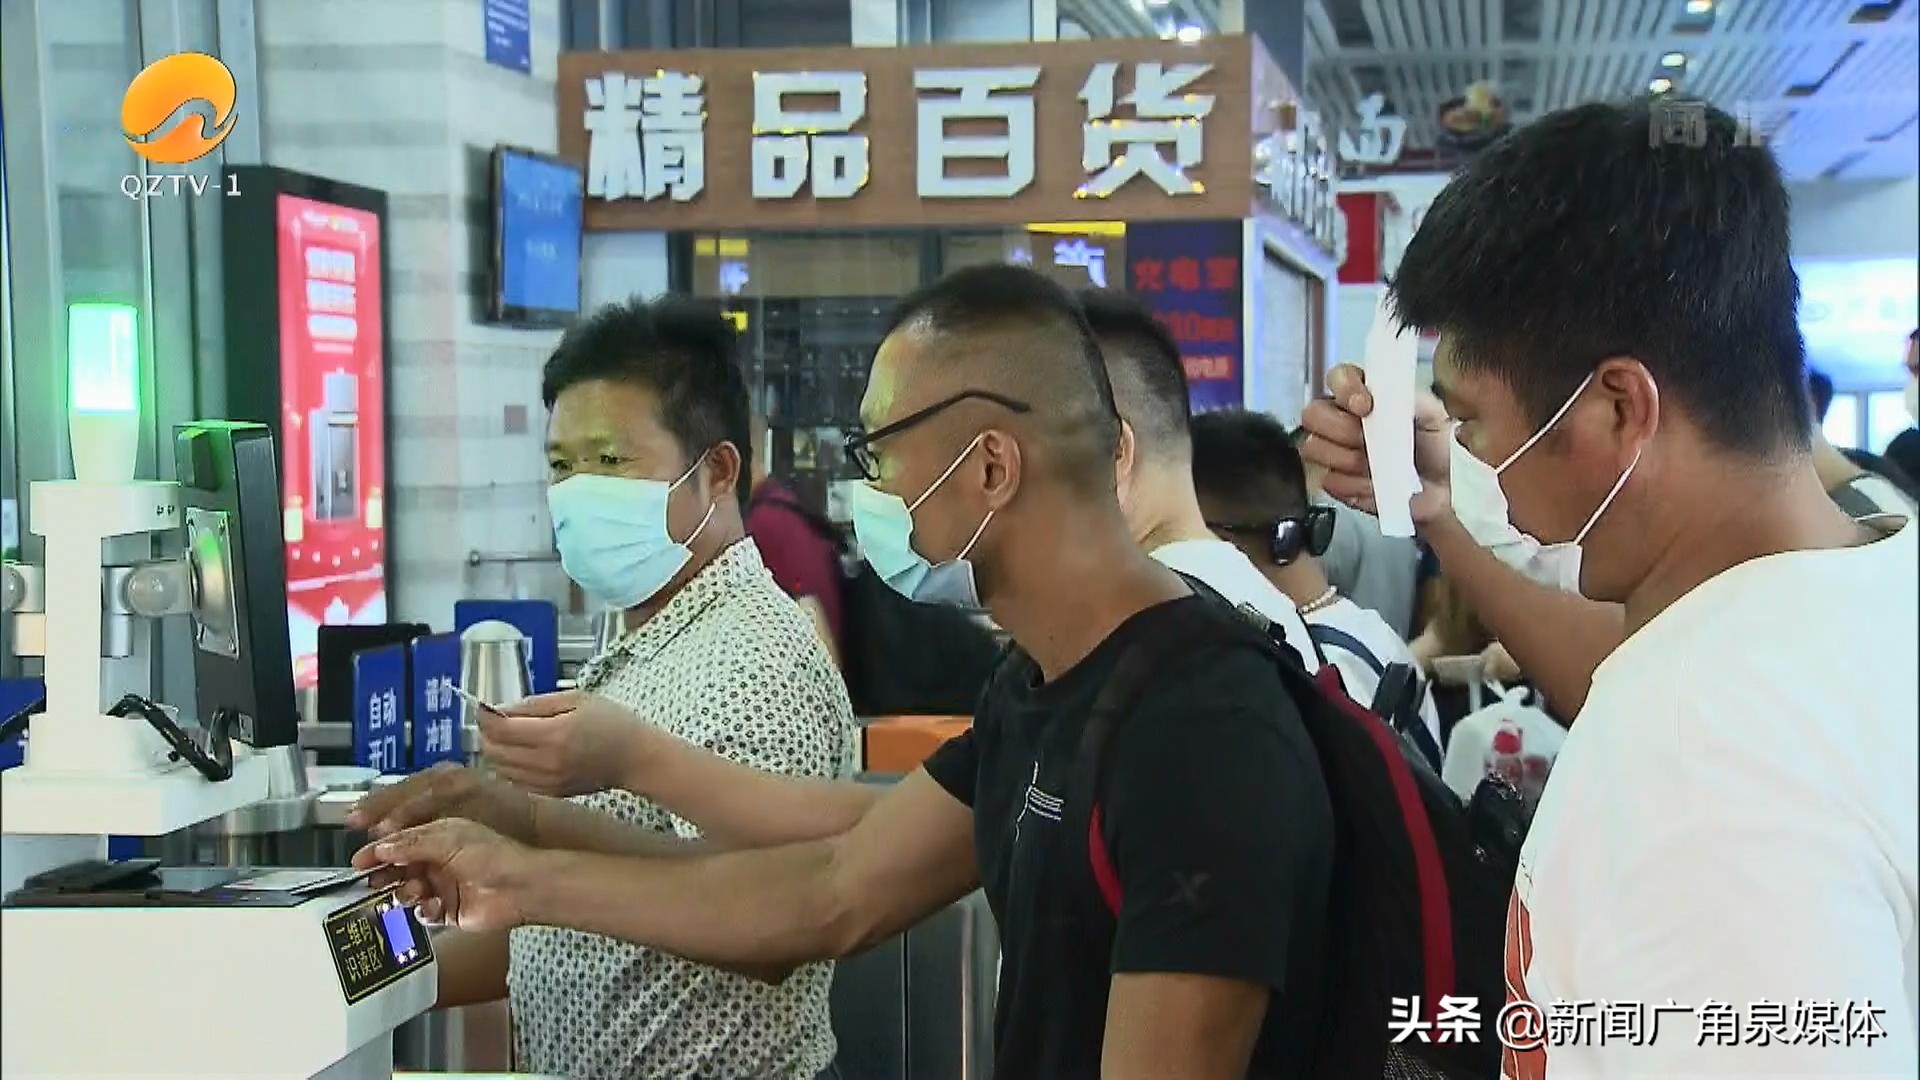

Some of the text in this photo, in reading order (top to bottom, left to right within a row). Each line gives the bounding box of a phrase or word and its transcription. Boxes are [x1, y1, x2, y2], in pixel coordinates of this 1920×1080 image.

[583, 62, 1217, 201] 精品百货
[369, 688, 397, 729] 自动
[368, 735, 397, 770] 开门
[335, 917, 374, 952] 二维码
[345, 944, 383, 982] 识读区
